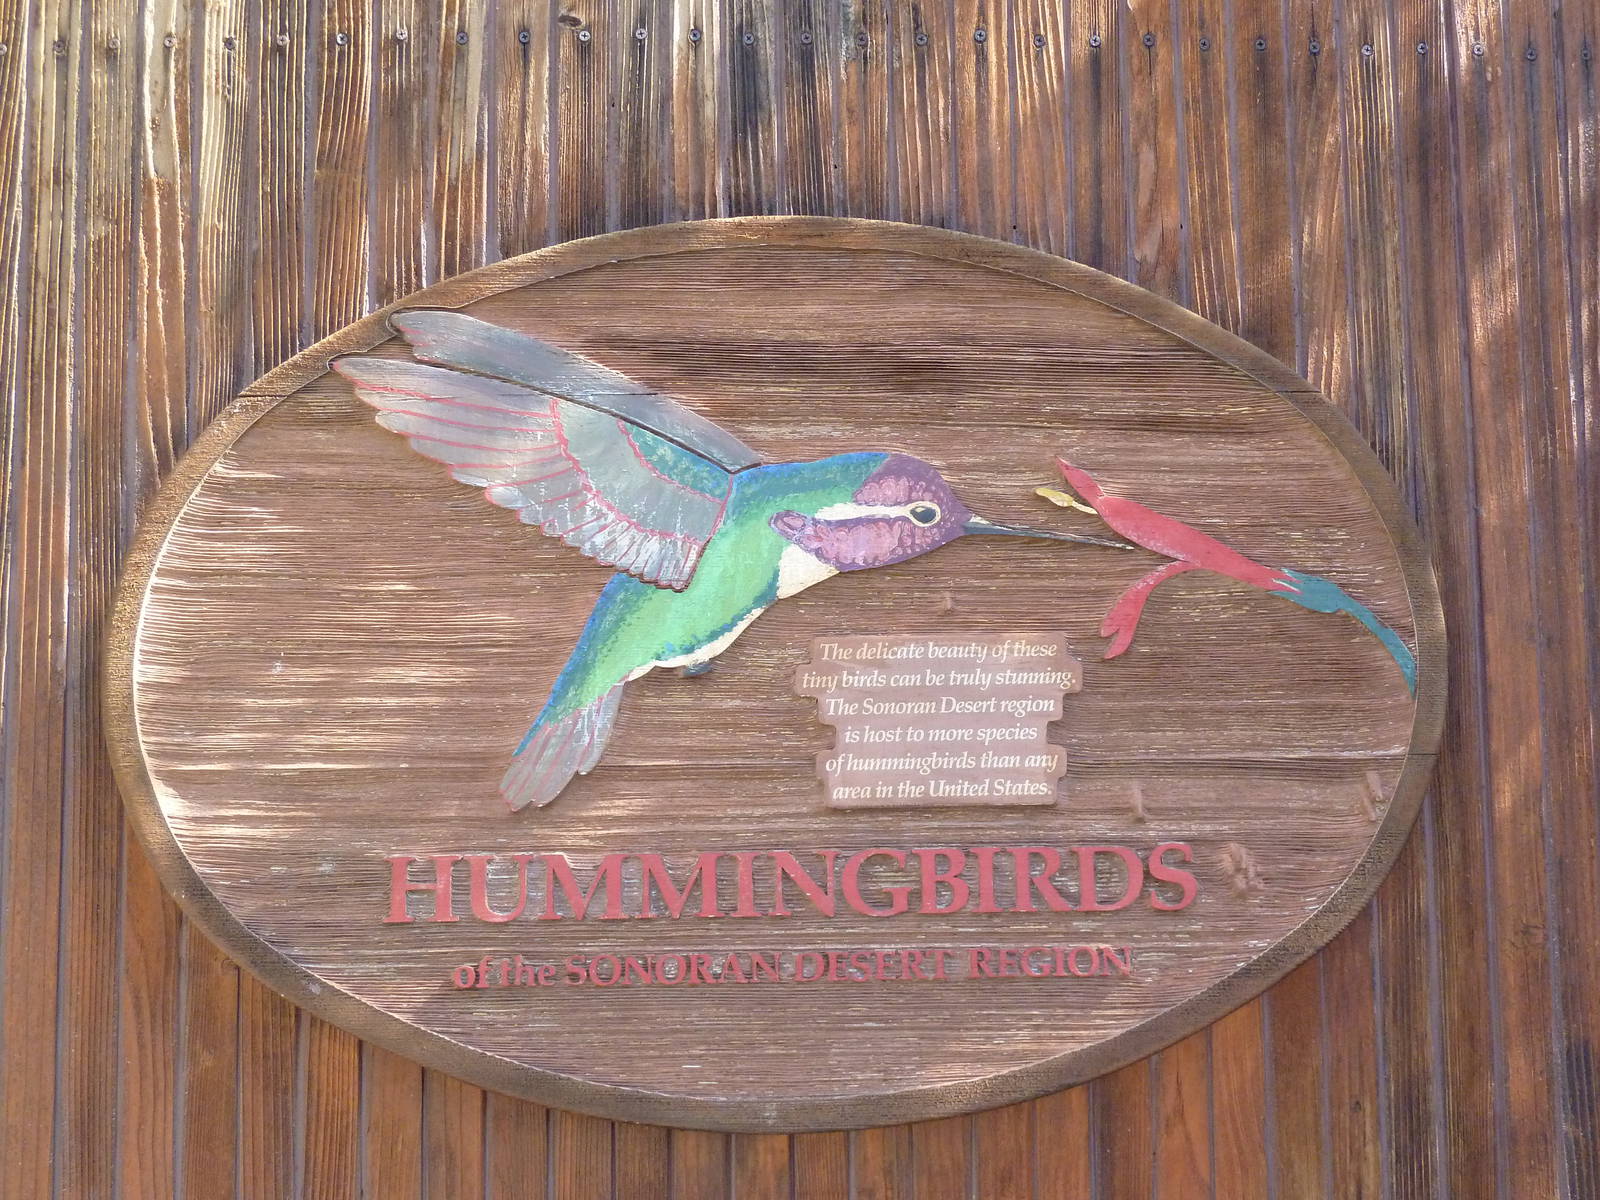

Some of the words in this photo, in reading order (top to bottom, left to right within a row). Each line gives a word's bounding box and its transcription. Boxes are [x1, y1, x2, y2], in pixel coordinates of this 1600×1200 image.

[820, 643, 850, 660] The
[855, 642, 923, 660] delicate
[928, 641, 988, 662] beauty
[991, 641, 1011, 662] of
[1012, 641, 1057, 658] these
[802, 672, 840, 693] tiny
[841, 670, 887, 688] birds
[890, 673, 921, 687] can
[925, 669, 945, 687] be
[949, 668, 993, 690] truly
[995, 667, 1076, 690] stunning.
[826, 698, 857, 716] The
[862, 698, 937, 715] Sonoran
[940, 697, 997, 714] Desert
[1000, 695, 1055, 718] region
[844, 727, 860, 743] is
[863, 725, 903, 743] host
[906, 727, 925, 742] to
[928, 729, 974, 742] more
[976, 724, 1038, 745] species
[825, 754, 848, 774] of
[848, 752, 976, 775] hummingbirds
[980, 751, 1020, 768] than
[1024, 754, 1059, 773] any
[832, 786, 871, 800] area
[875, 782, 893, 798] in
[897, 781, 924, 798] the
[929, 779, 989, 797] United
[993, 779, 1052, 797] States.
[383, 842, 1198, 924] HUMMINGBIRDS
[453, 955, 494, 990] of
[501, 955, 556, 988] the
[565, 952, 781, 987] SONORAN
[794, 949, 953, 983] DESERT
[967, 945, 1134, 979] REGION
